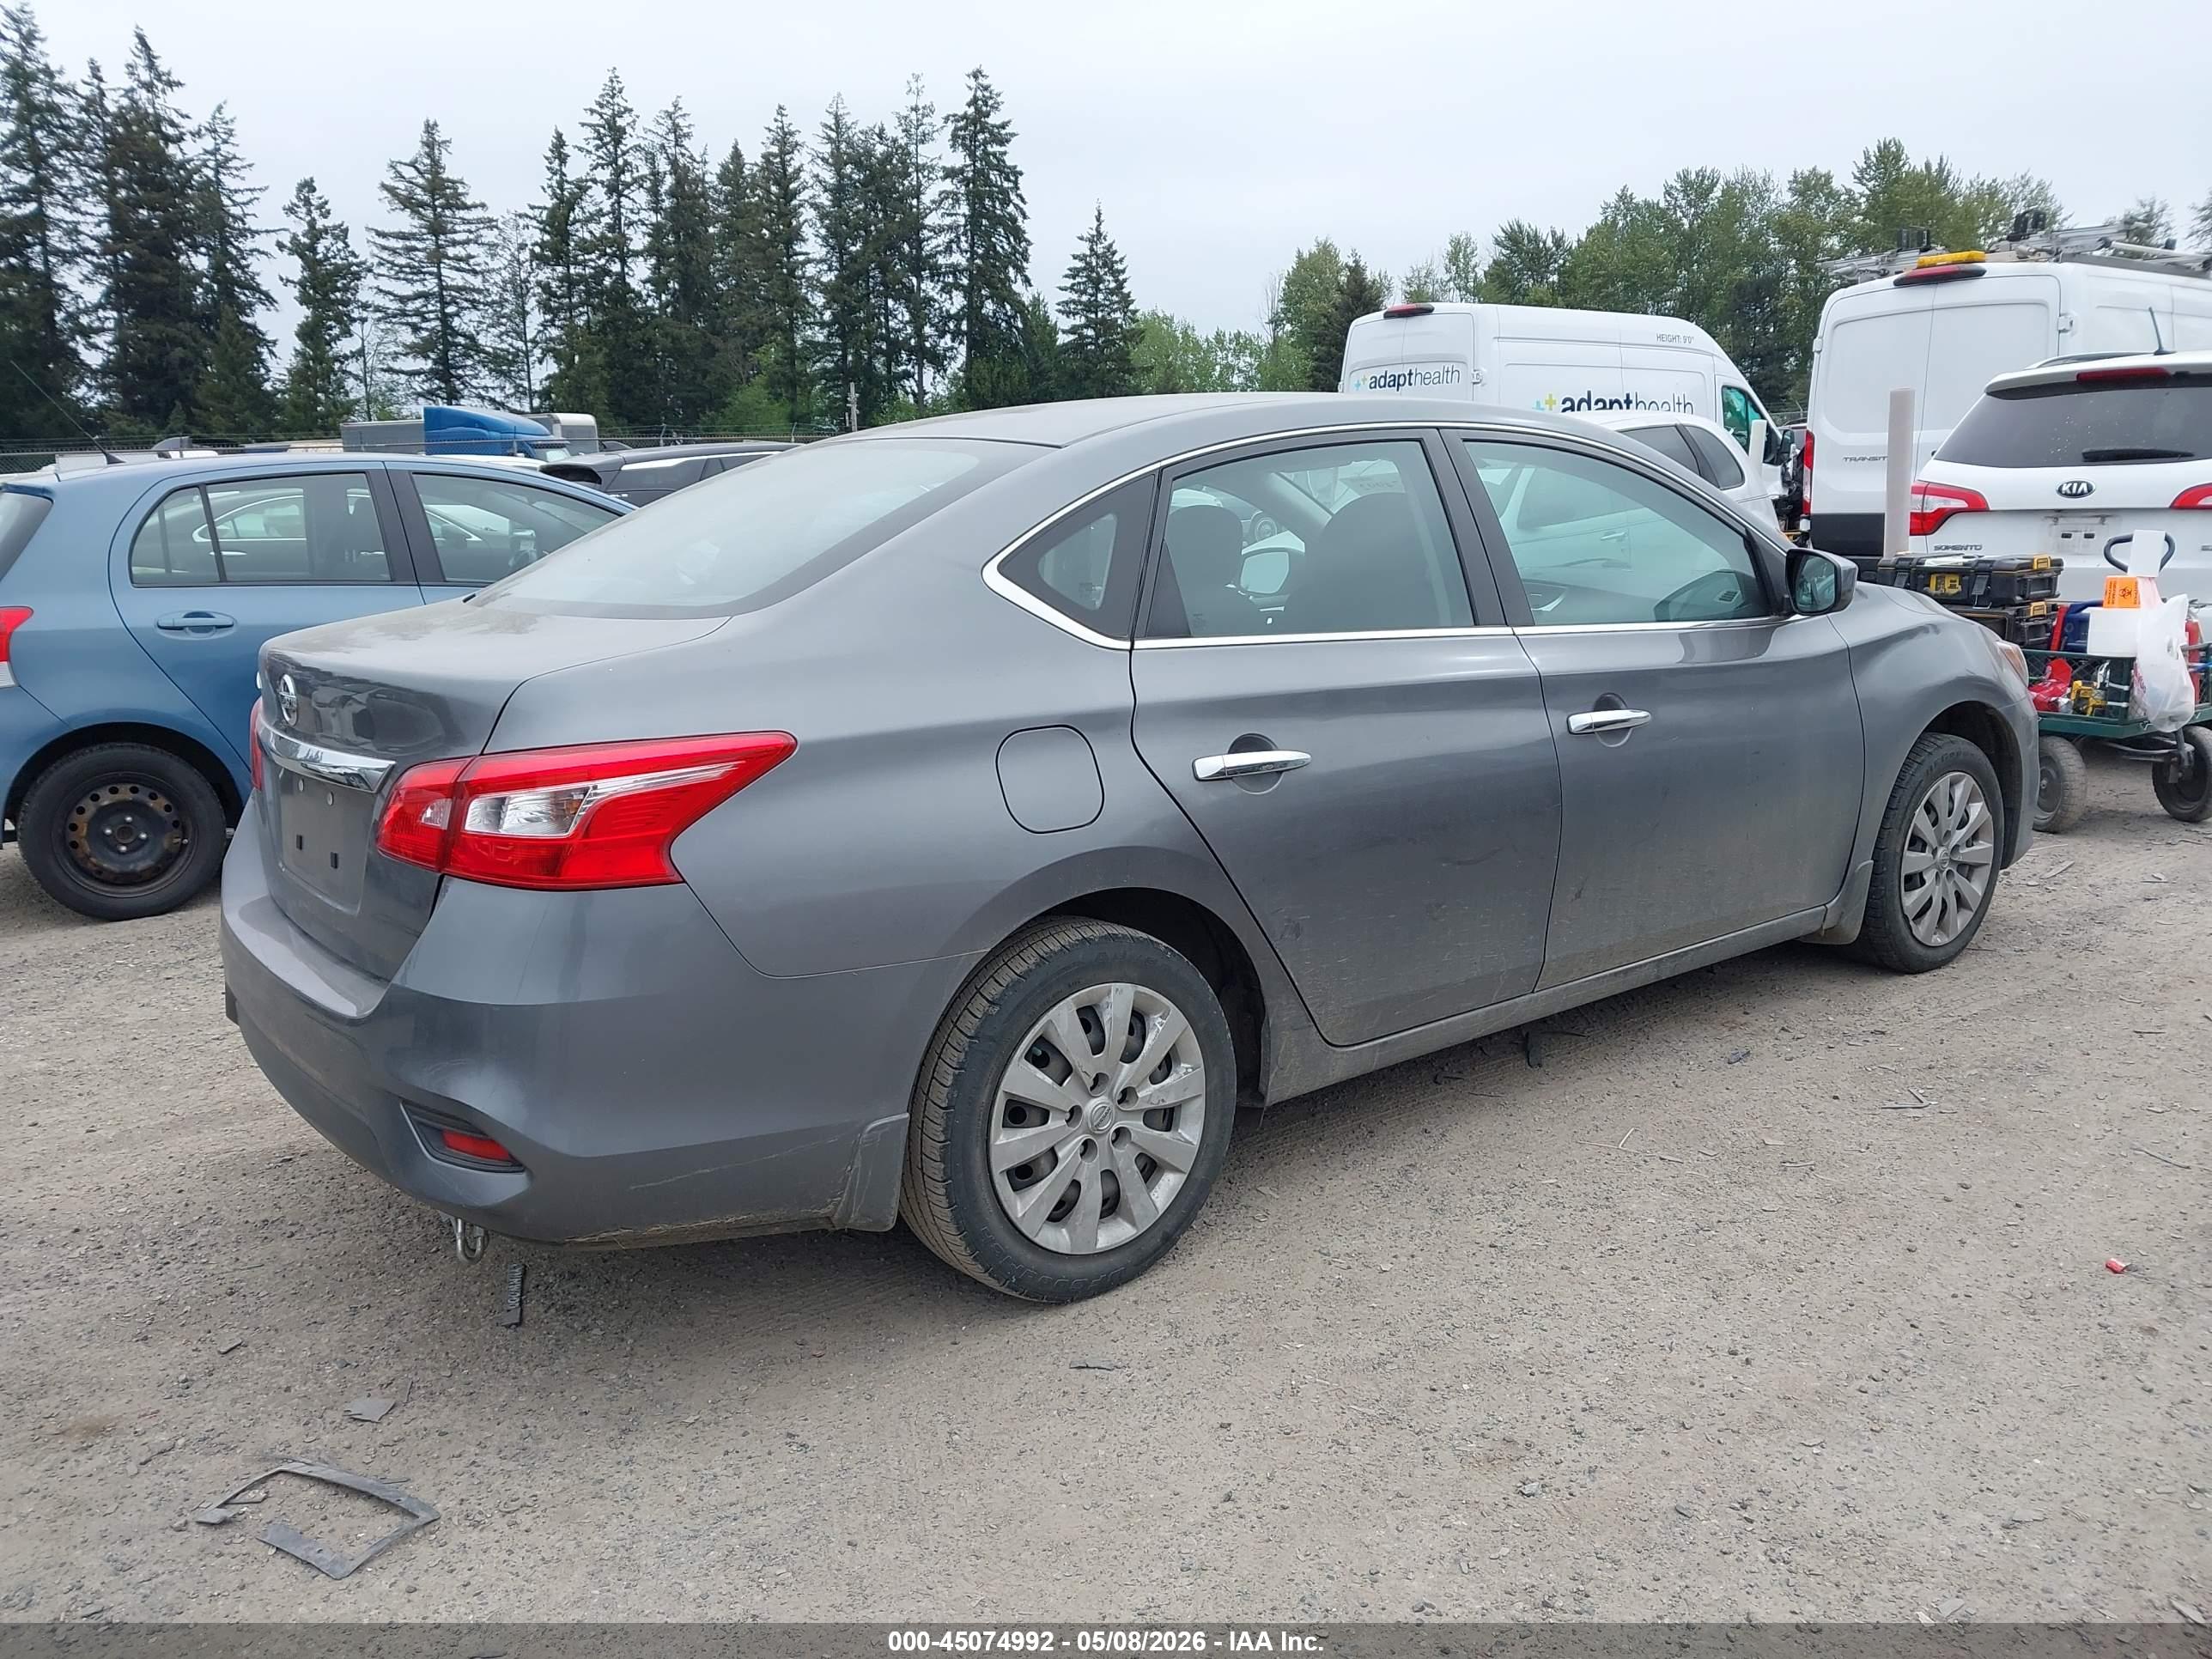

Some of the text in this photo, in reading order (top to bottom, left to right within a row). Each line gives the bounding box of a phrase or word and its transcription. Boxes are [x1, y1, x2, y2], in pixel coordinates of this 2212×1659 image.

[1656, 333, 1682, 343] HEIGHT:
[1369, 365, 1461, 392] adapthealth
[2062, 483, 2088, 495] KIA
